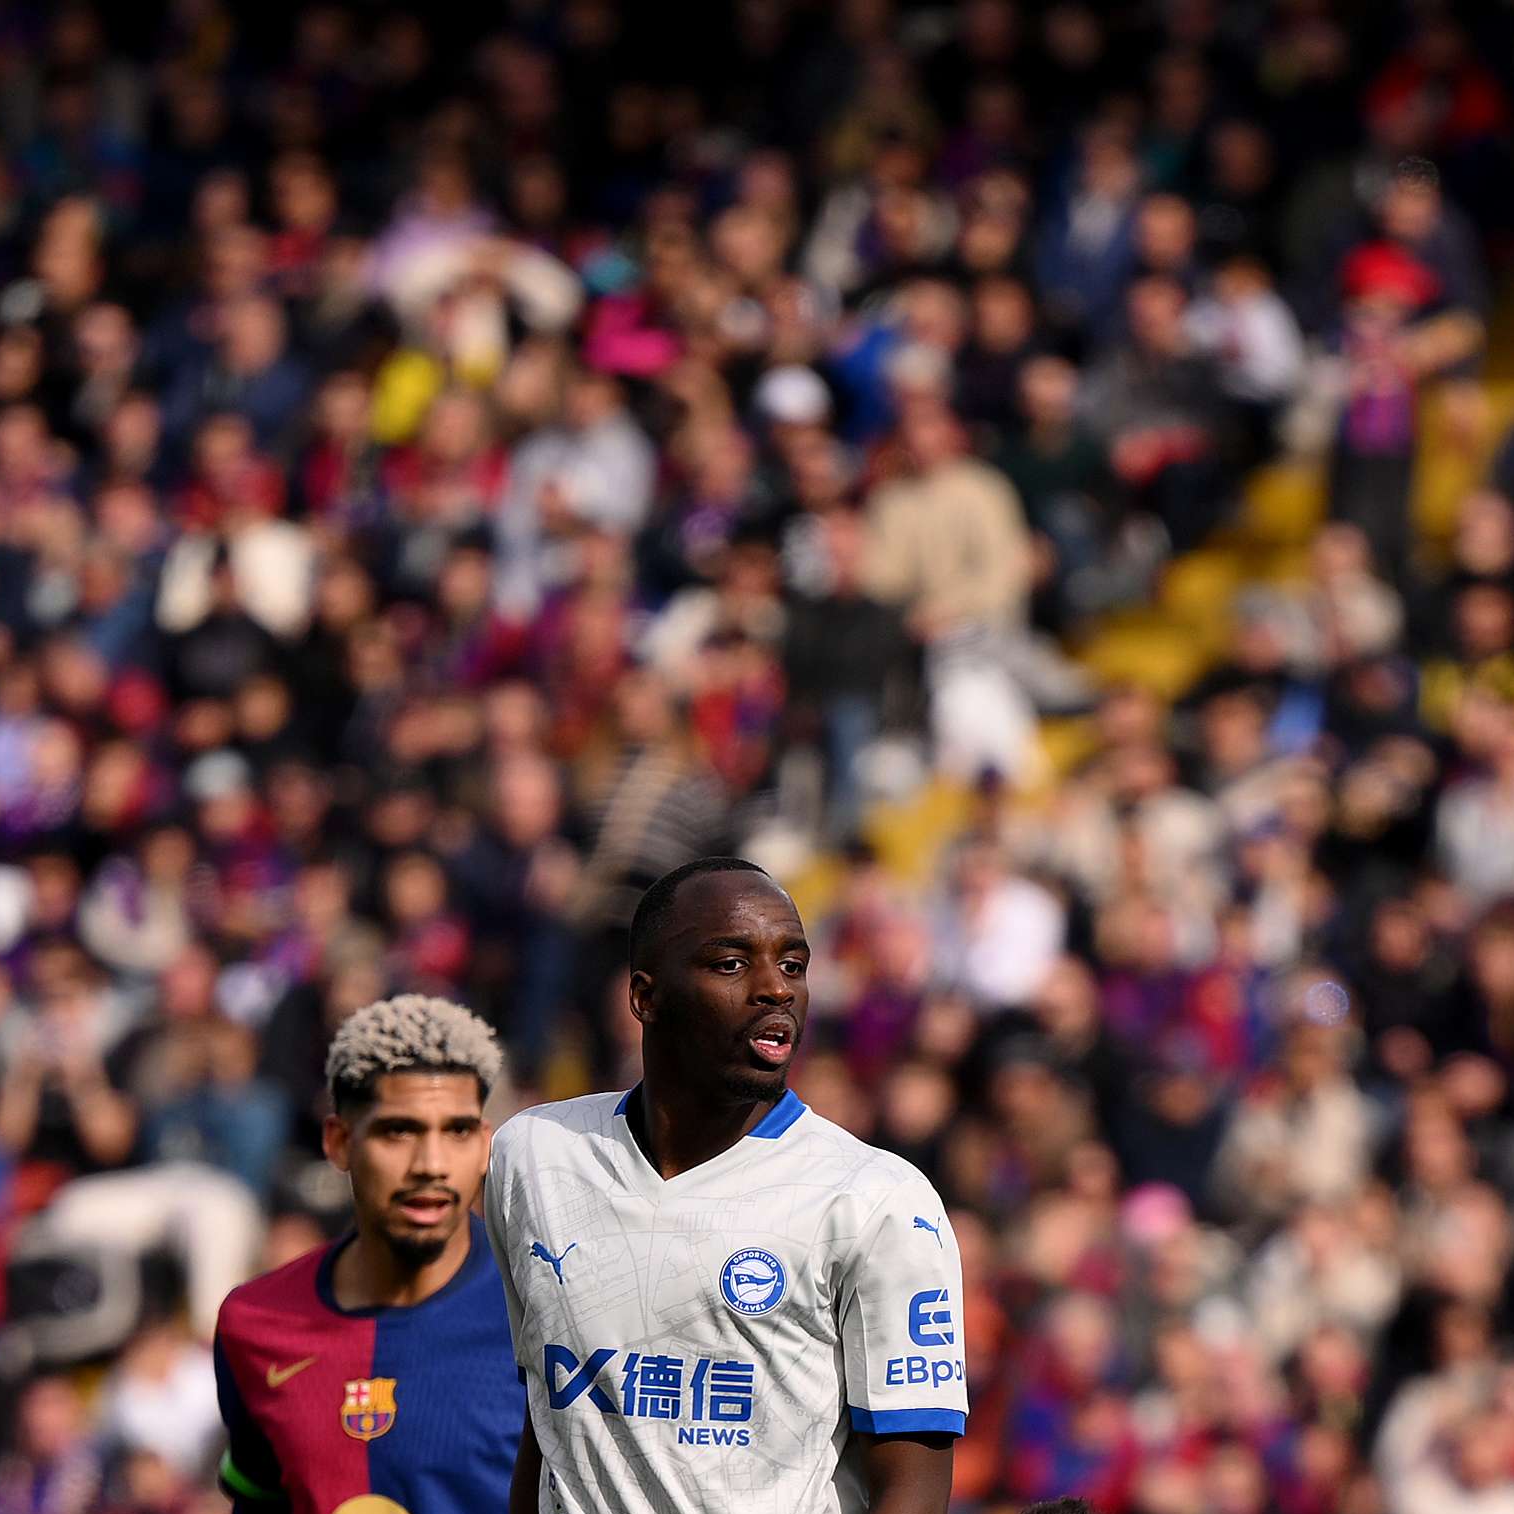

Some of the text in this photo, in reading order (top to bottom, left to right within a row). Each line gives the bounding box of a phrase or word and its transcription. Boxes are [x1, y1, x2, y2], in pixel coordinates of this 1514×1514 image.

[732, 1251, 778, 1268] DEPORTIVO
[885, 1355, 965, 1389] EBpa
[677, 1427, 751, 1447] NEWS
